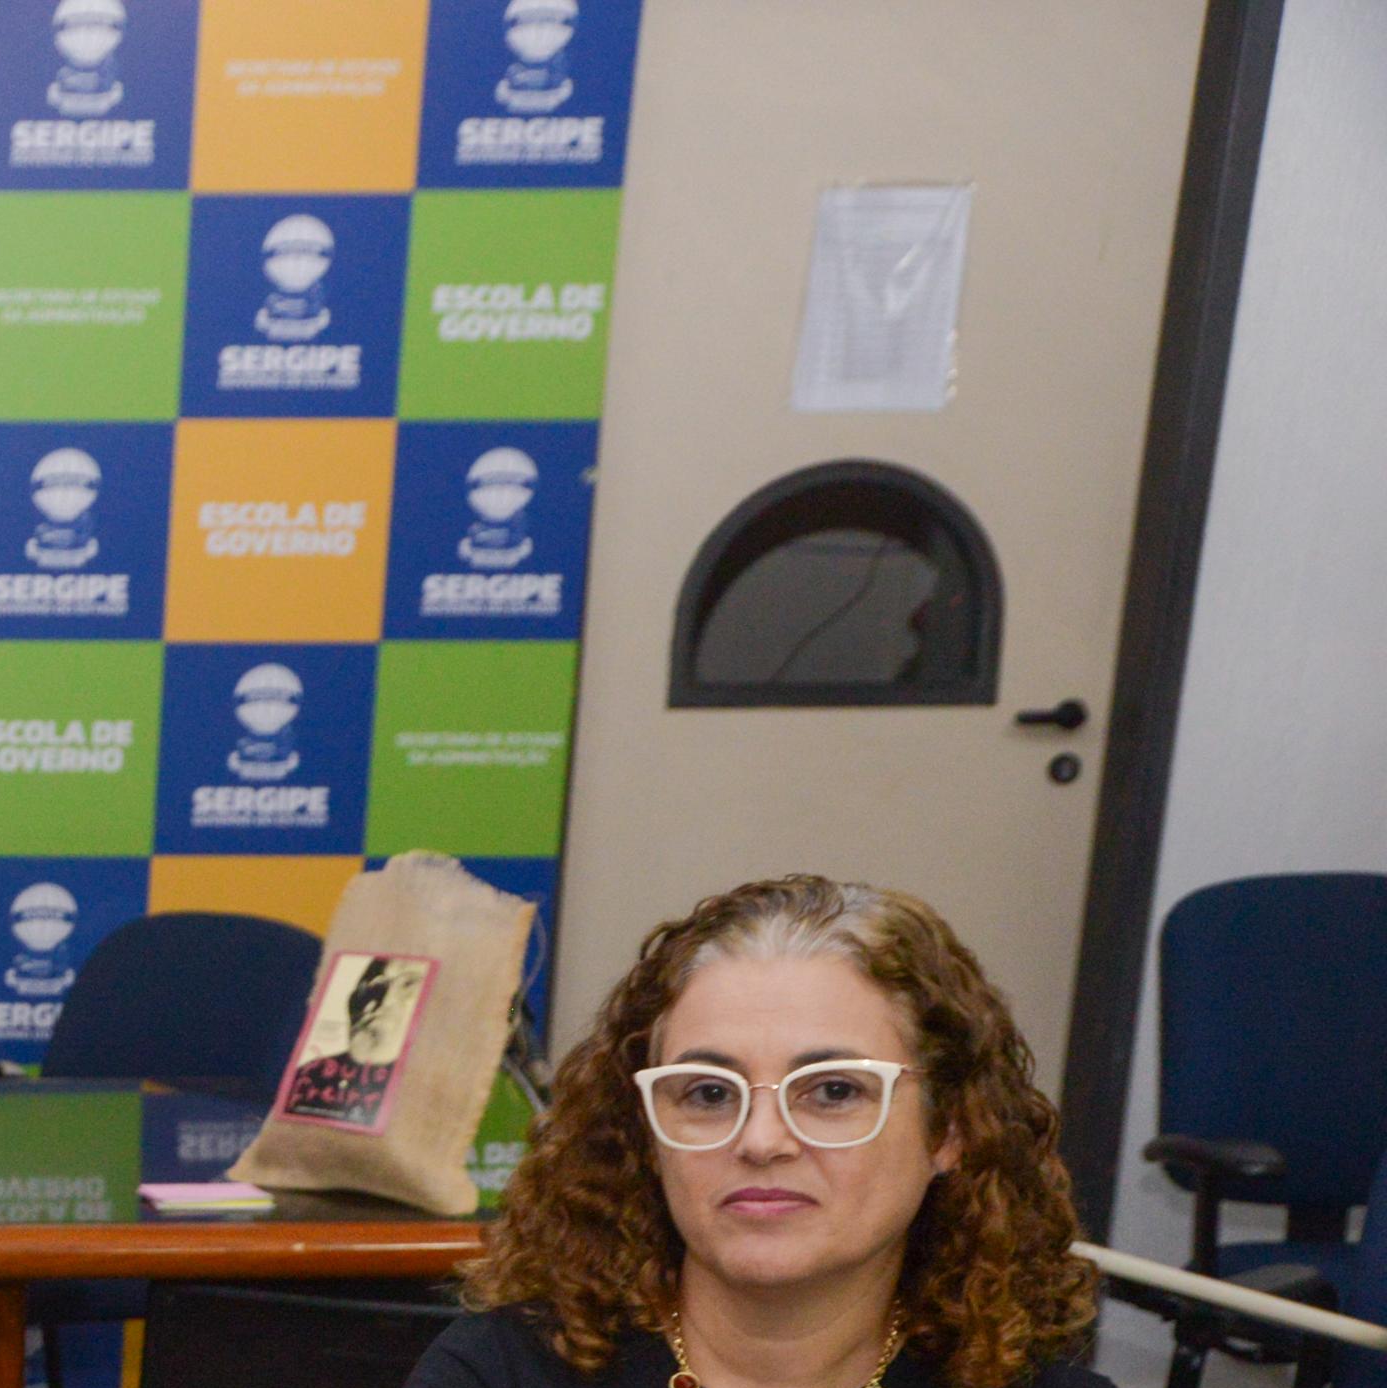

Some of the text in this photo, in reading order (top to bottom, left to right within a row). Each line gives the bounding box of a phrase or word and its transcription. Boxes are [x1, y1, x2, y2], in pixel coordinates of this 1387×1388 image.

[12, 122, 154, 151] SERGIPE
[458, 118, 604, 149] SERGIPE
[432, 284, 604, 314] ESCOLA DE
[437, 312, 594, 341] GOVERNO
[220, 347, 361, 375] SERGIPE
[199, 502, 366, 531] ESCOLA DE
[204, 529, 357, 557] GOVERNO
[423, 575, 563, 602] SERGIPE
[91, 720, 133, 745] DE
[194, 788, 329, 814] SERGIPE
